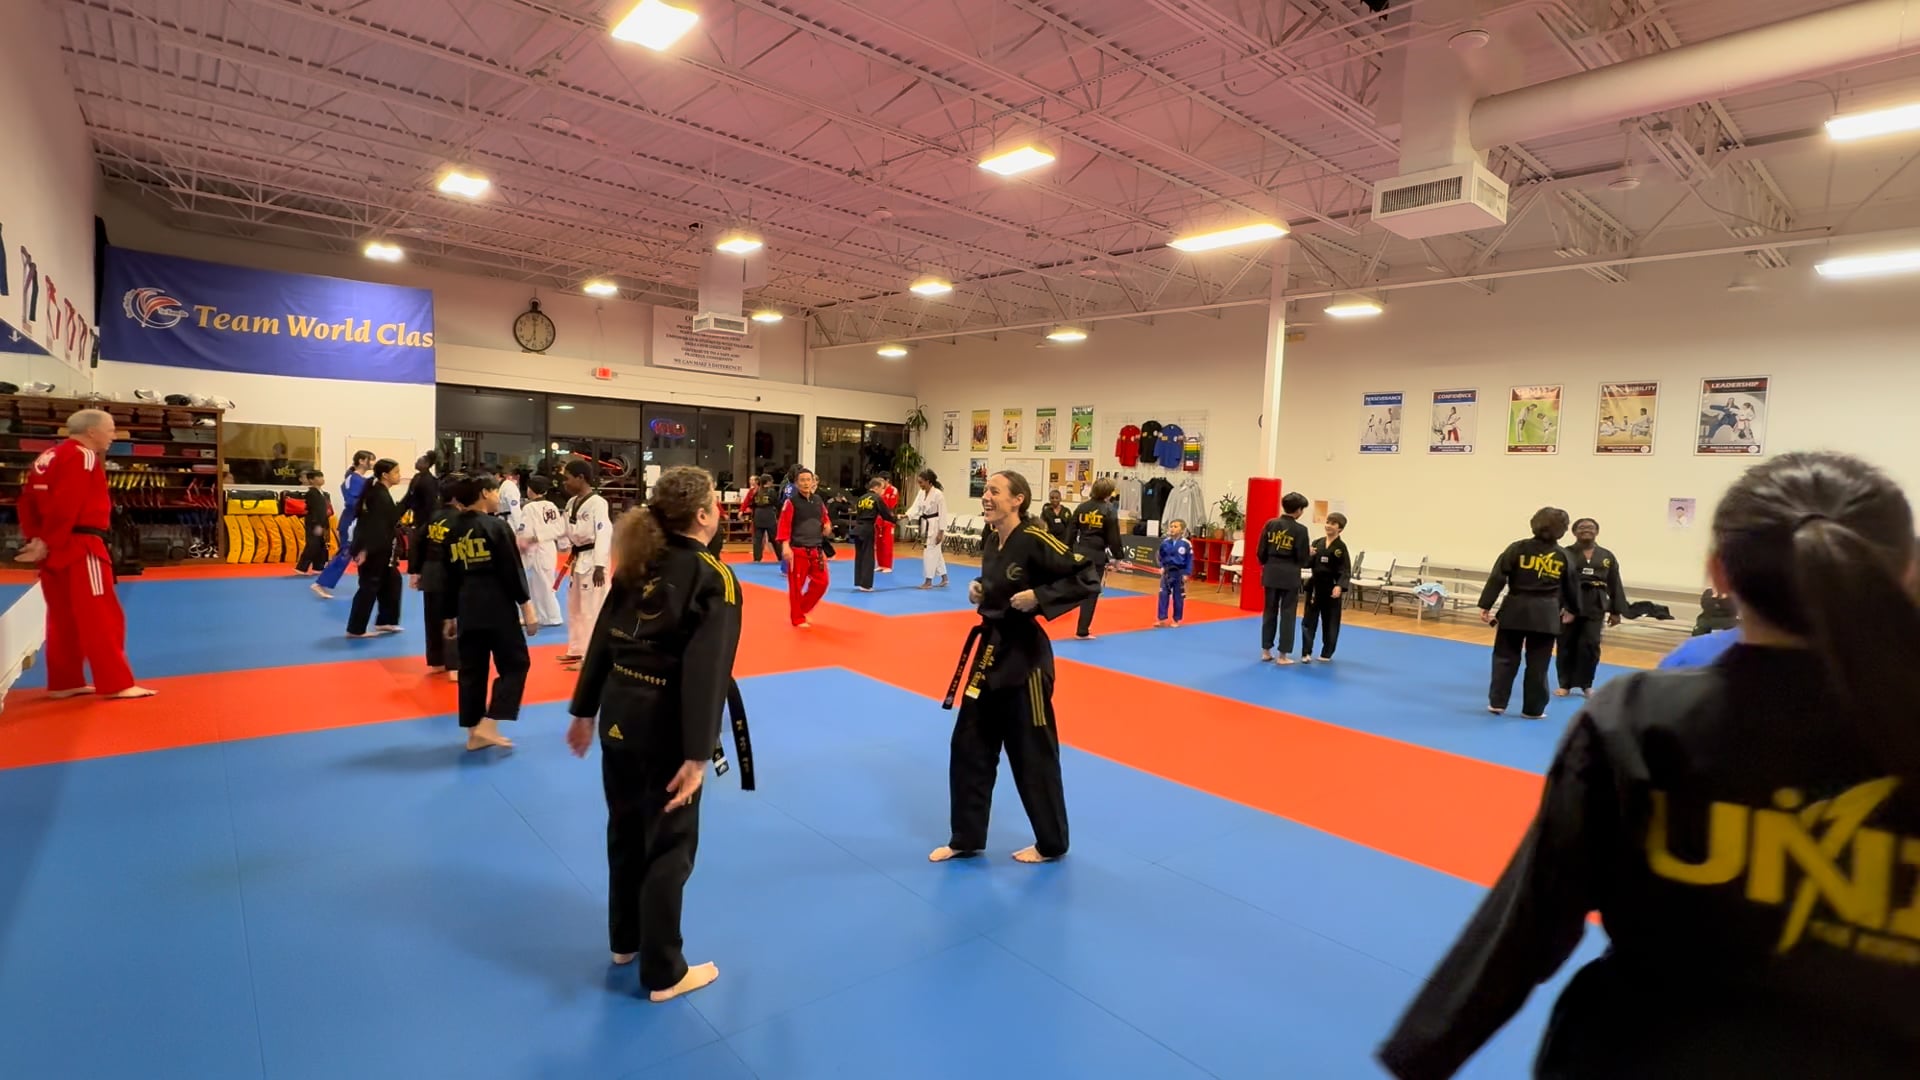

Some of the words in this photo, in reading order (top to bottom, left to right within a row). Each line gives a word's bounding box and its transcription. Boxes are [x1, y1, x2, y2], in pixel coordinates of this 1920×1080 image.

[193, 304, 280, 335] Team
[286, 314, 371, 343] World
[376, 323, 434, 348] Clas
[1711, 381, 1760, 389] LEADERSHIP
